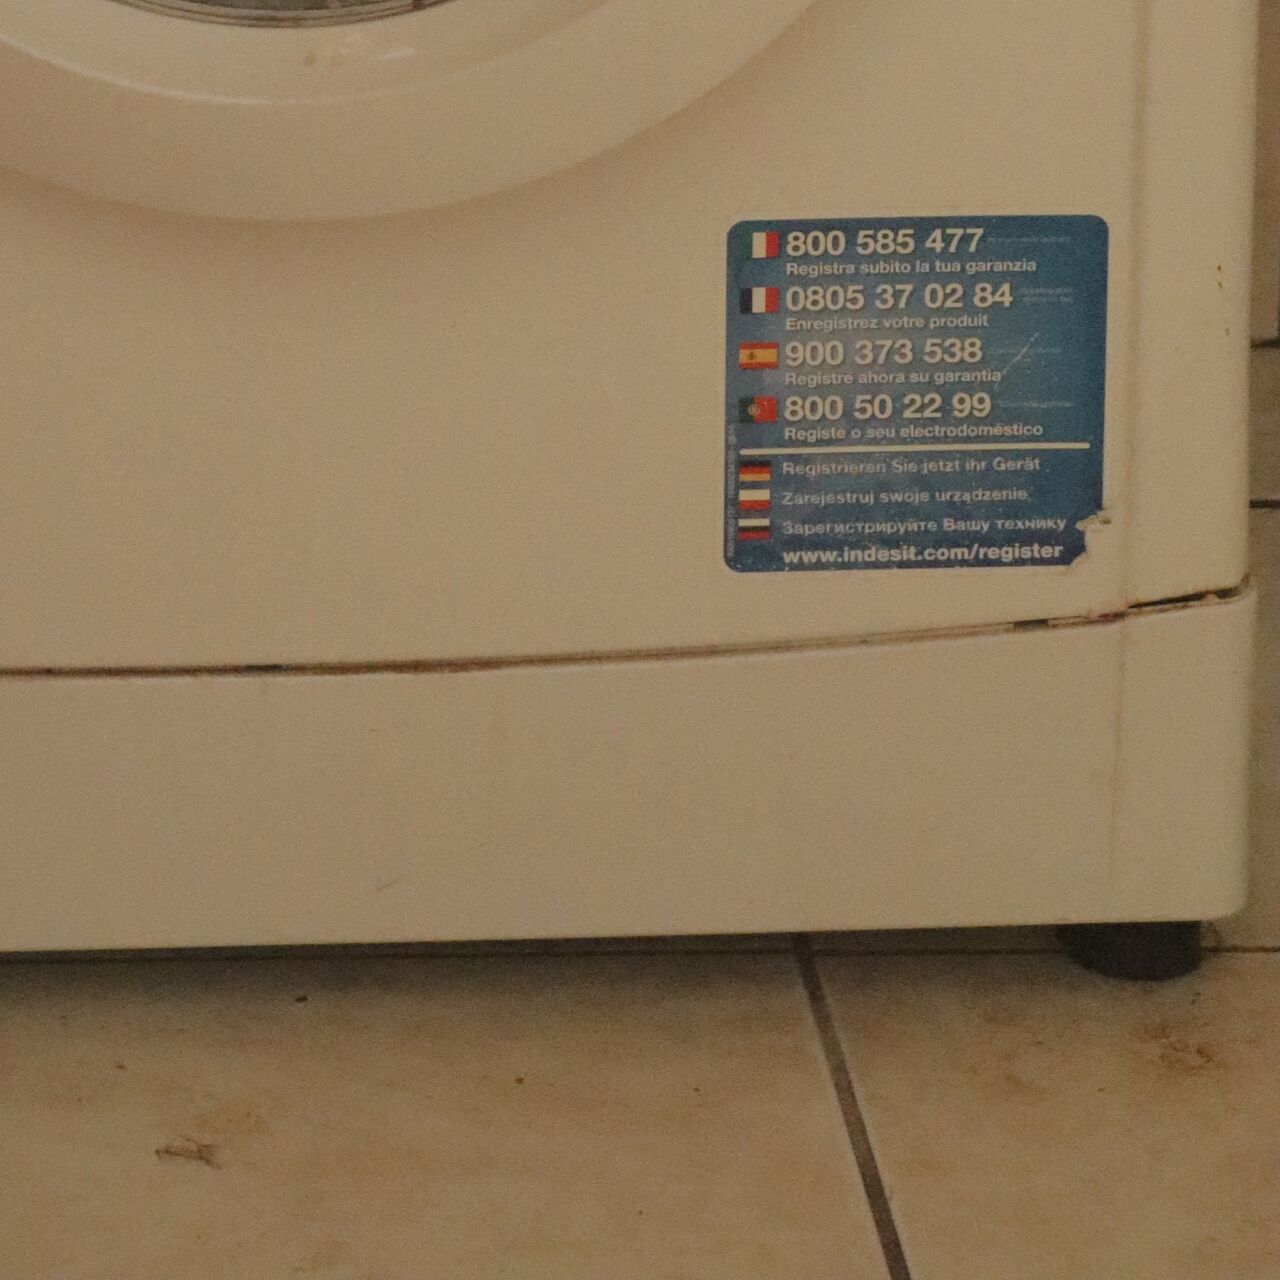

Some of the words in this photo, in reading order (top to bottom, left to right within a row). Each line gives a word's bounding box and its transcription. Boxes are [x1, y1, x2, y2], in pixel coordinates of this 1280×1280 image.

[785, 229, 846, 257] 800
[856, 228, 915, 255] 585
[924, 227, 985, 254] 477
[786, 261, 856, 278] Registra
[860, 260, 912, 275] subito
[915, 260, 930, 273] la
[934, 260, 961, 274] tua
[965, 257, 1037, 276] garanzia
[785, 284, 865, 312] 0805
[874, 284, 915, 310] 37
[923, 282, 964, 309] 02
[973, 281, 1014, 308] 84
[785, 315, 879, 332] Enregistrez
[882, 314, 925, 329] votre
[929, 313, 989, 331] produit
[784, 340, 845, 367] 900
[854, 339, 914, 365] 373
[922, 338, 983, 364] 538
[858, 370, 906, 385] ahora
[909, 370, 929, 384] su
[783, 395, 844, 422] 800
[853, 393, 893, 420] 50
[902, 392, 943, 419] 22
[951, 391, 993, 418] 99
[850, 428, 862, 439] o
[866, 427, 896, 440] seu
[782, 459, 887, 477] Registrieren
[891, 458, 918, 474] Sie
[921, 458, 961, 476] jetzt
[991, 455, 1042, 472] Gerät
[781, 488, 876, 507] Zarejestruj
[879, 489, 930, 506] swoje
[934, 486, 1028, 505] urządzenie
[782, 519, 938, 539] Зарегистрируйте
[942, 517, 993, 536] Вашу
[995, 516, 1068, 534] технику
[782, 541, 1064, 565] www.indesit.com/register
